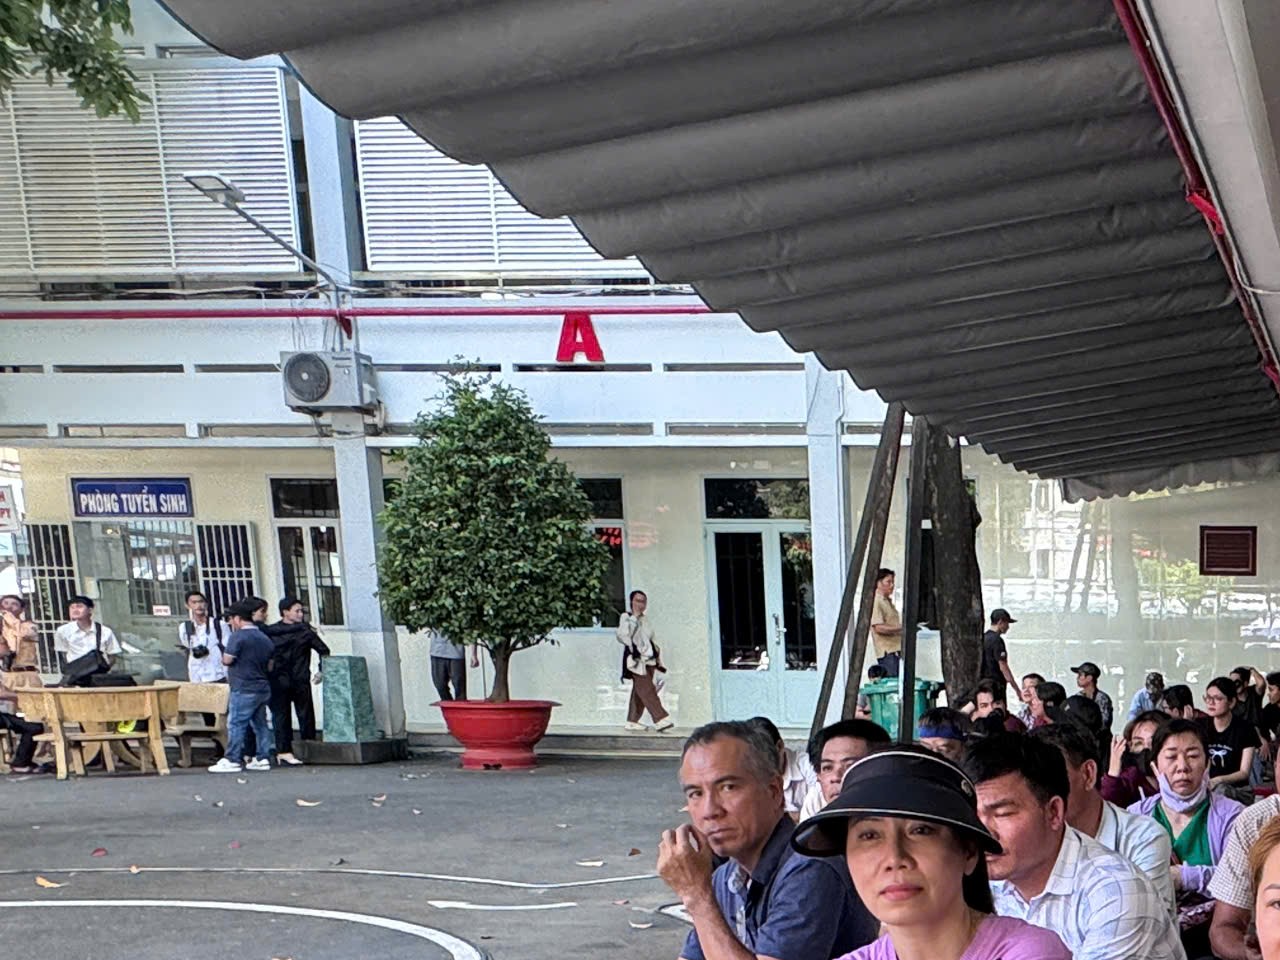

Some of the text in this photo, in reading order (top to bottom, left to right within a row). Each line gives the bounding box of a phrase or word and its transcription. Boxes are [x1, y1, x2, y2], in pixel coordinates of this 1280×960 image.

[556, 311, 605, 362] A
[79, 485, 188, 513] PHÒNG TUYỂN SINH
